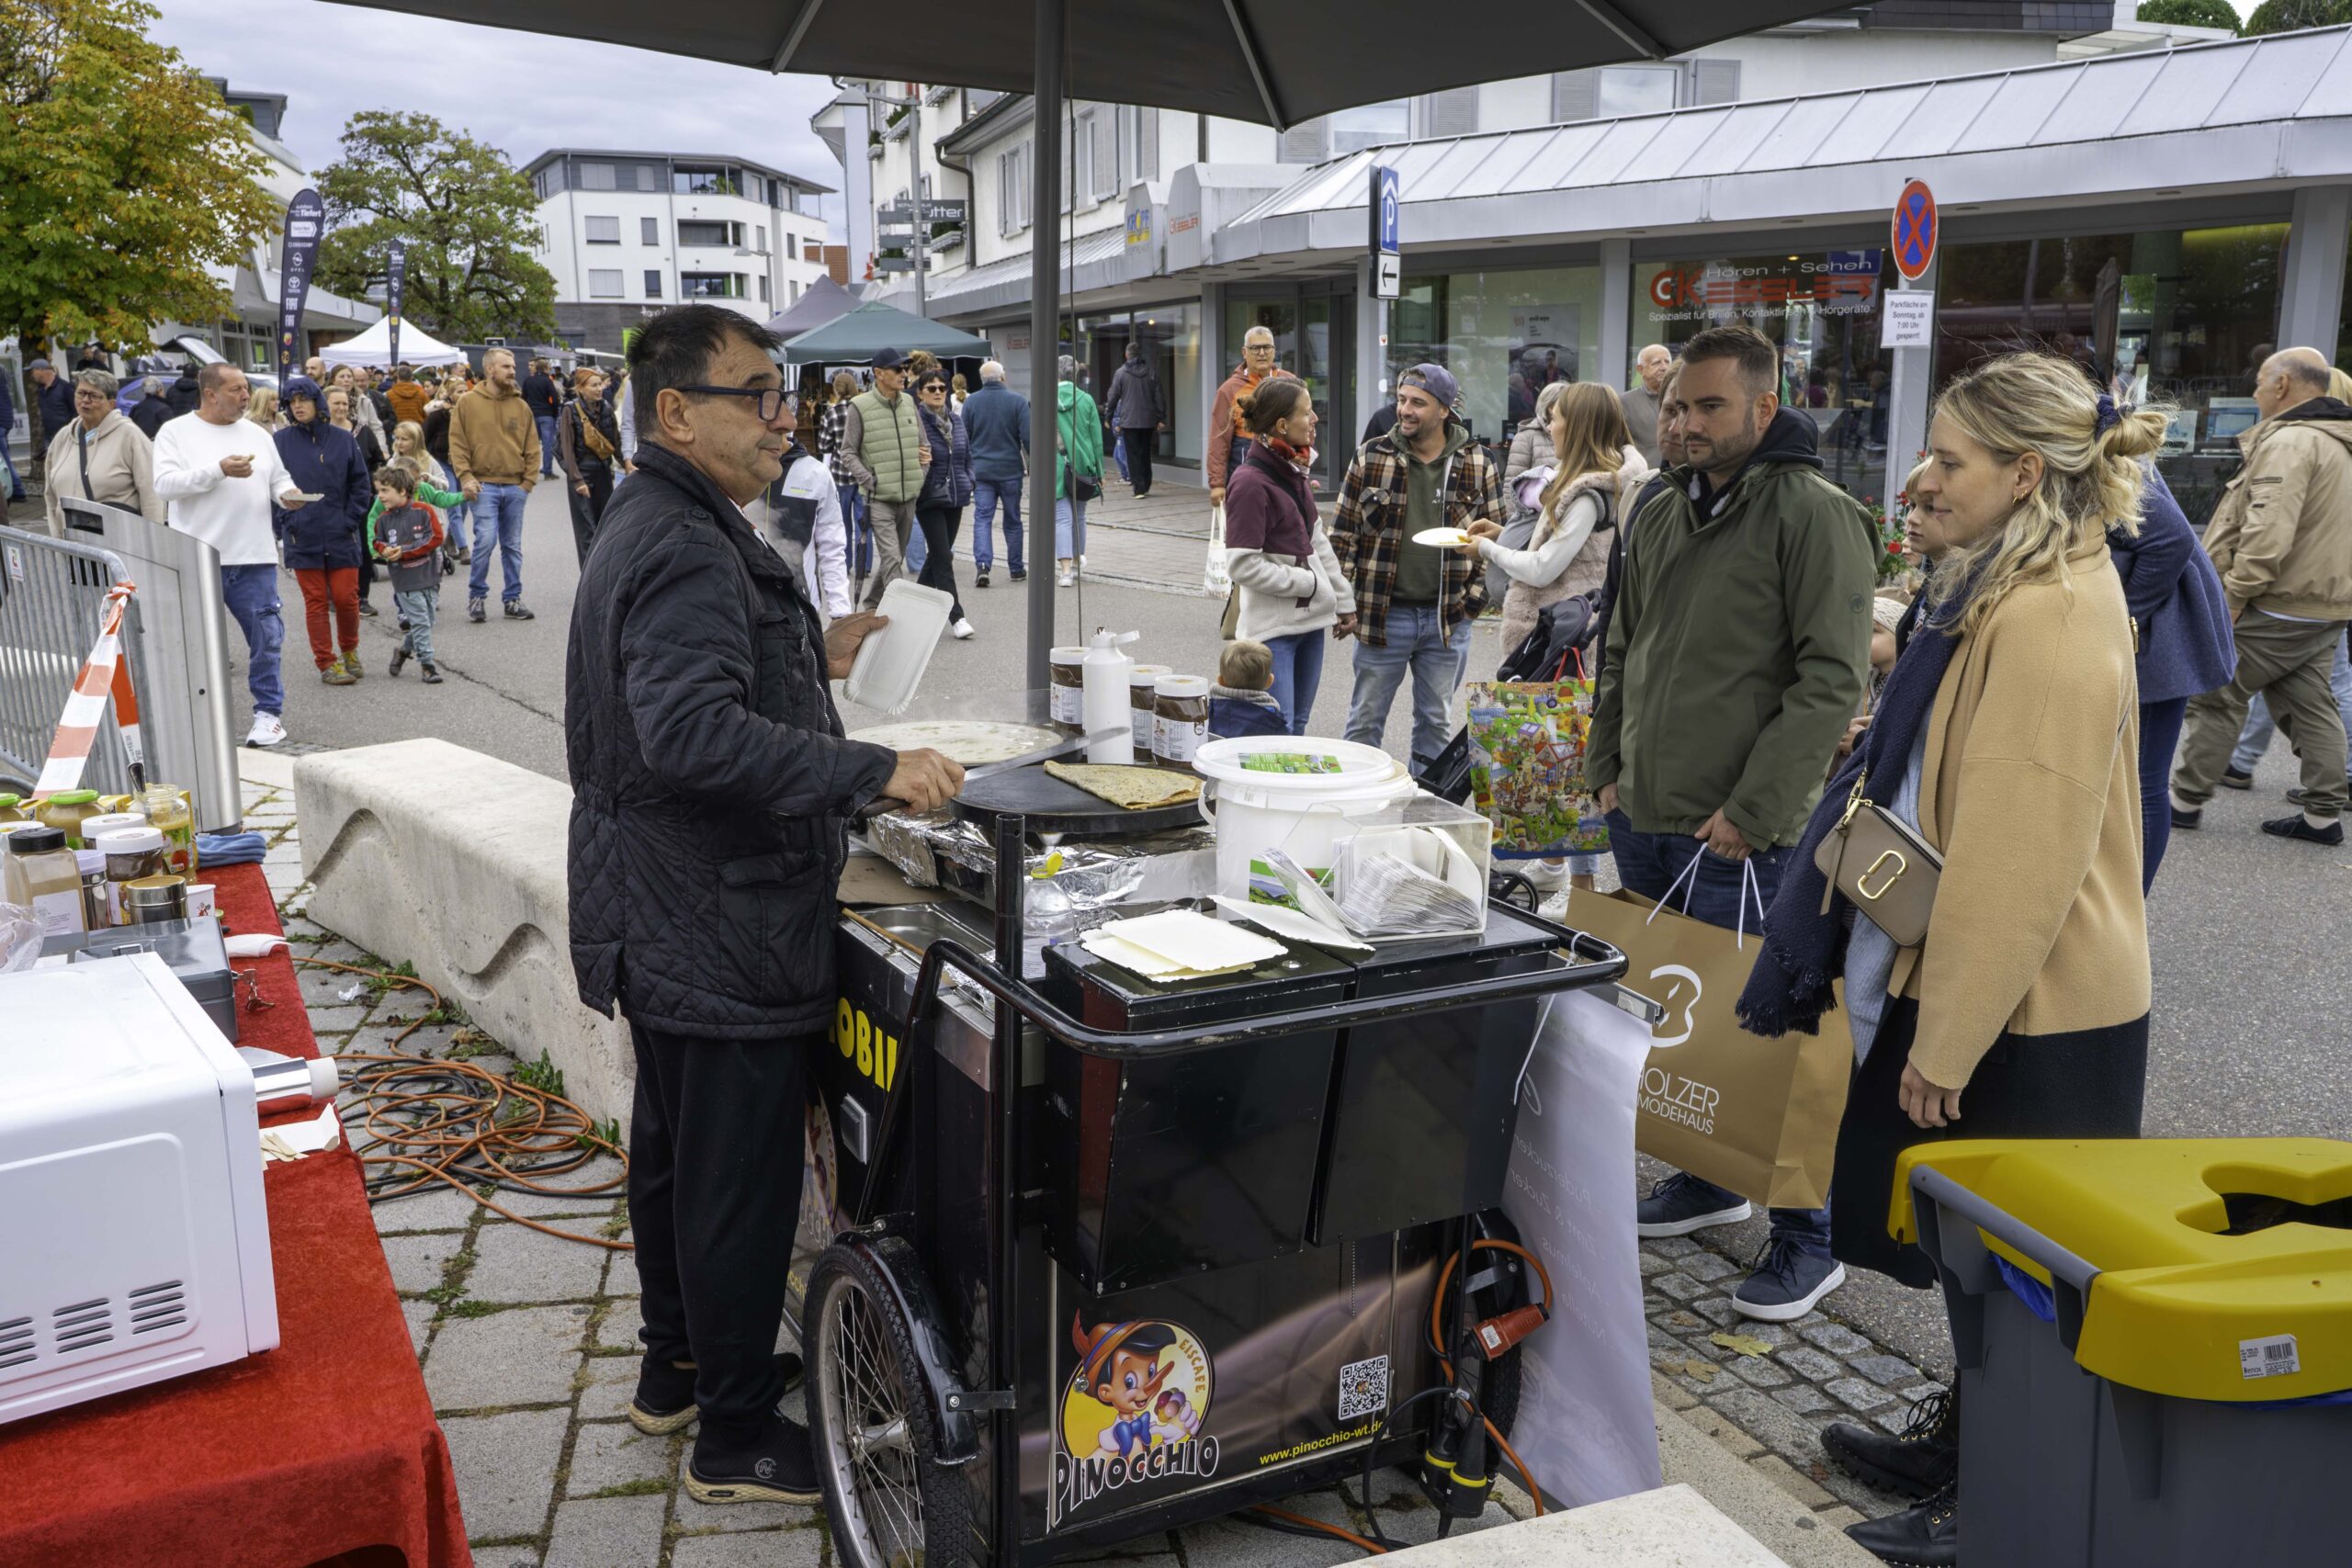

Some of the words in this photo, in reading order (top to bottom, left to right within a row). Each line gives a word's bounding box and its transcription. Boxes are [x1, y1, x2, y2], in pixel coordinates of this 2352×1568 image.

[300, 209, 322, 218] Tiefert
[1386, 195, 1395, 243] P
[1706, 266, 1769, 277] Hören
[1801, 261, 1871, 274] Sehen
[286, 298, 299, 310] FIAT
[1648, 310, 1691, 321] Spezialist
[1693, 311, 1705, 321] für
[1819, 305, 1871, 316] Hörgeräte
[1638, 1094, 1714, 1134] MODEHAUS
[1179, 1338, 1205, 1393] EISCAFE
[1046, 1435, 1219, 1535] PINOCCHIO
